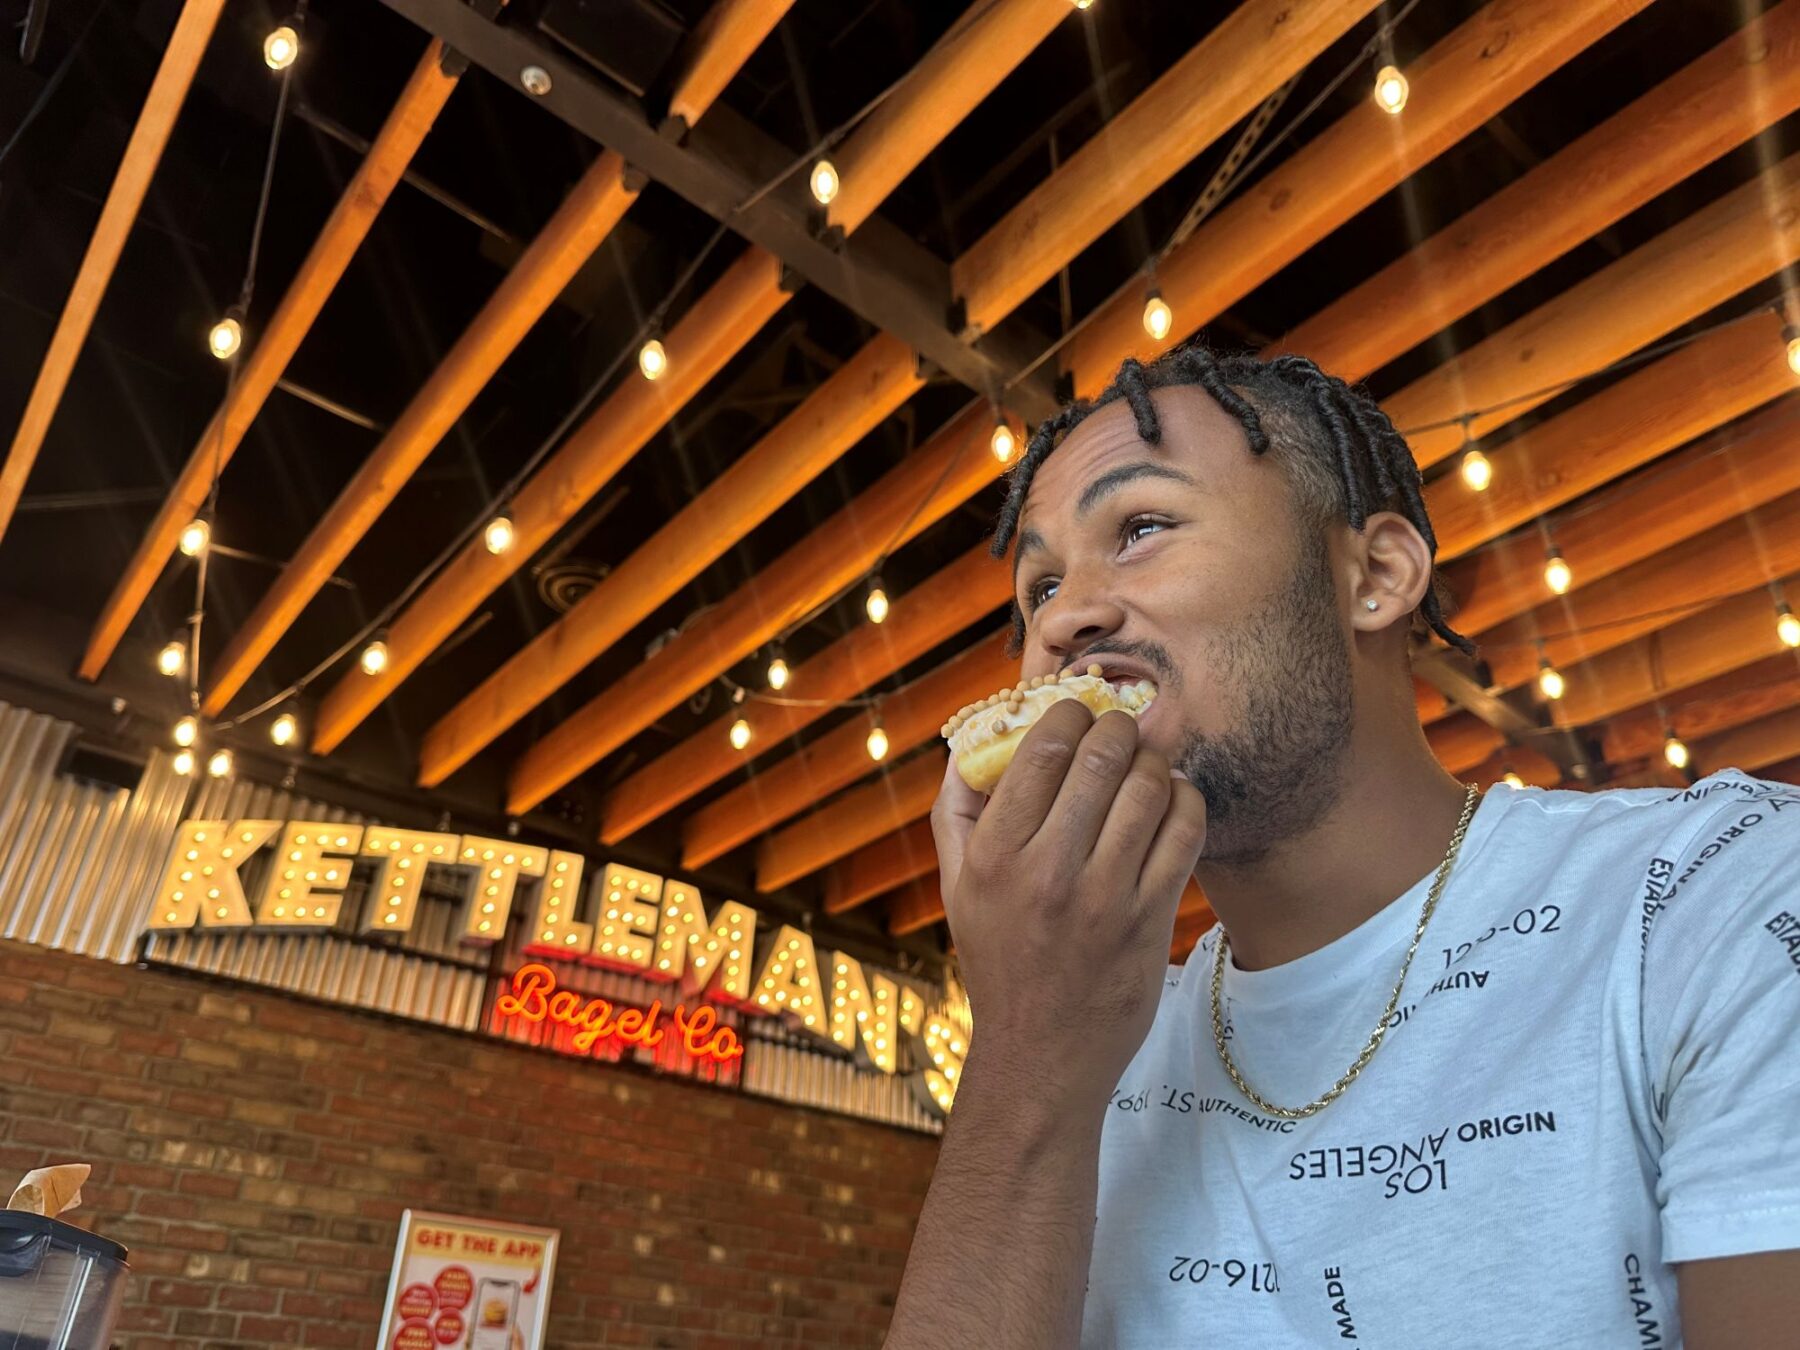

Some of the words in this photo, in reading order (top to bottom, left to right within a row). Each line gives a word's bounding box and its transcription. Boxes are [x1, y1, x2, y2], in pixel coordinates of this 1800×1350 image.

[497, 963, 664, 1050] Bagel
[674, 1004, 744, 1061] Co
[1199, 1098, 1297, 1134] AUTHENTIC
[1457, 1111, 1557, 1143] ORIGIN
[1289, 1127, 1449, 1180] ANGELES
[1384, 1158, 1448, 1200] LOS
[416, 1228, 456, 1250] GET
[462, 1234, 498, 1254] THE
[502, 1240, 542, 1259] APP
[1324, 1266, 1358, 1340] MADE
[1624, 1252, 1663, 1350] CHAM
